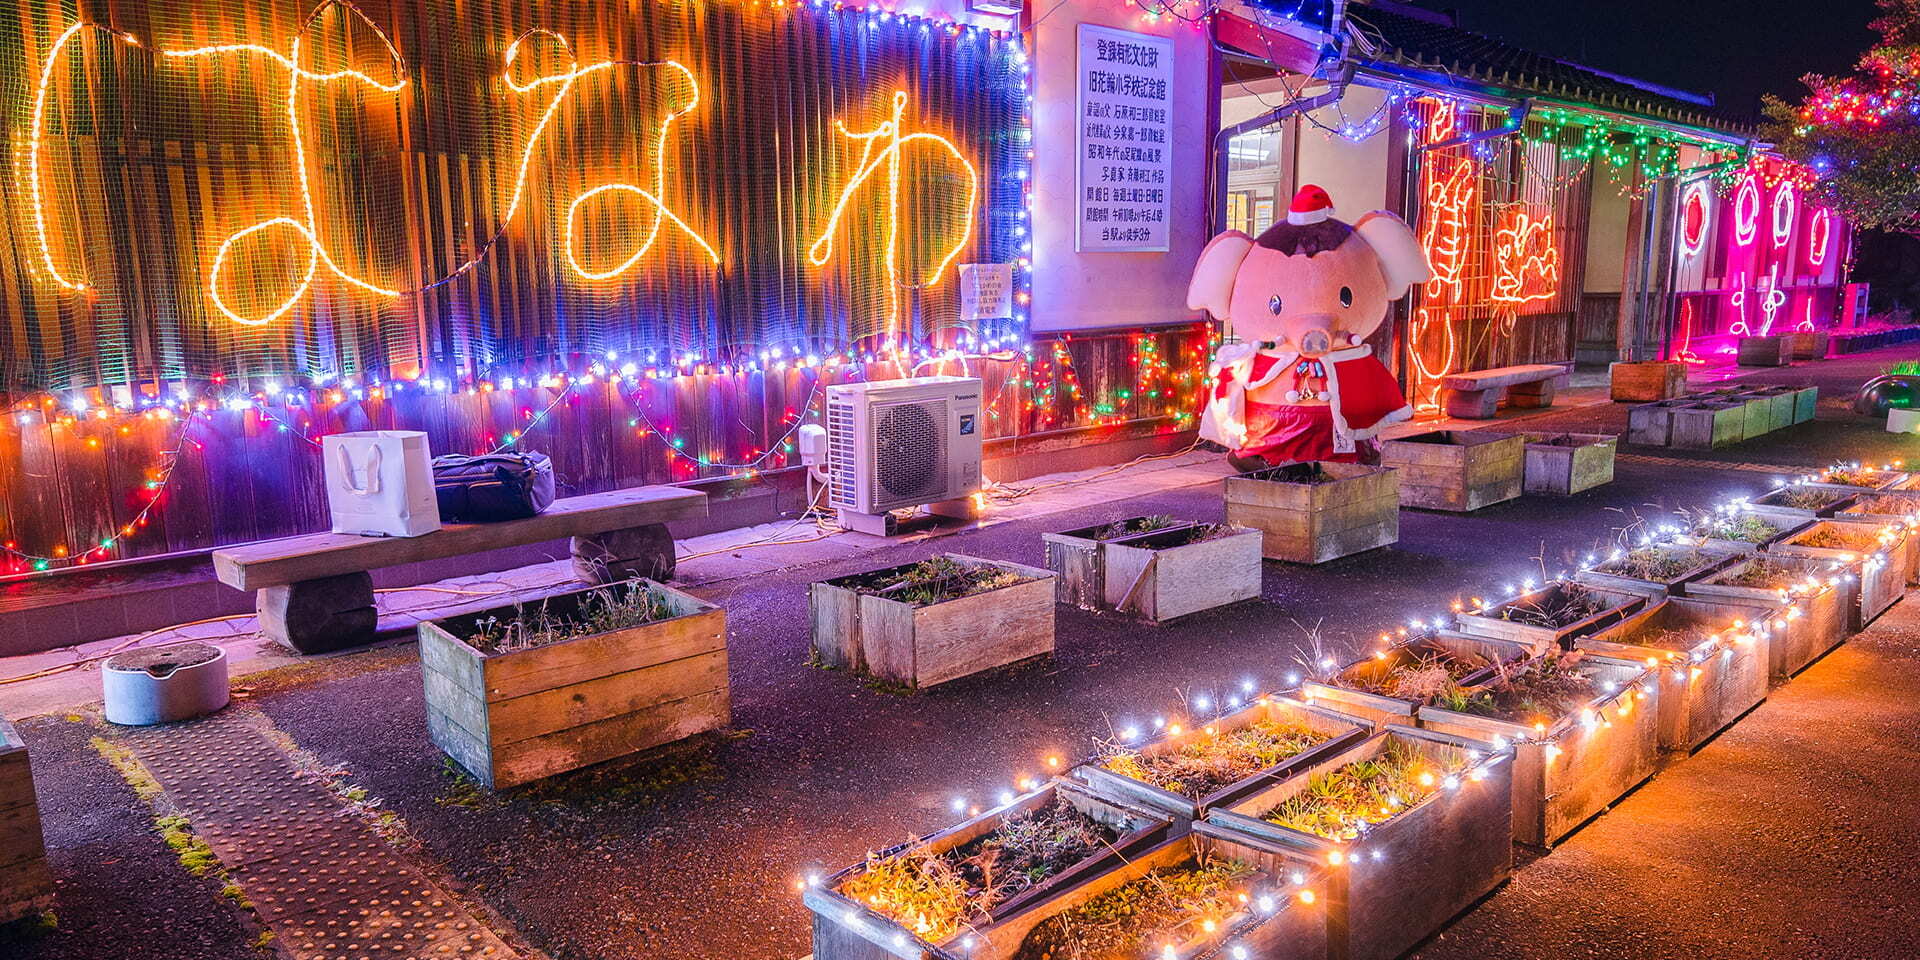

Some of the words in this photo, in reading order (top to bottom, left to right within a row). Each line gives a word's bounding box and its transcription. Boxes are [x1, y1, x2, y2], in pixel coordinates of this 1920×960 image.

[1096, 39, 1159, 68] 登録有形文化財
[1089, 70, 1167, 101] 旧花輪小学校記念館
[1086, 186, 1109, 202] 開館日
[1102, 227, 1151, 241] 当駅より徒歩3分
